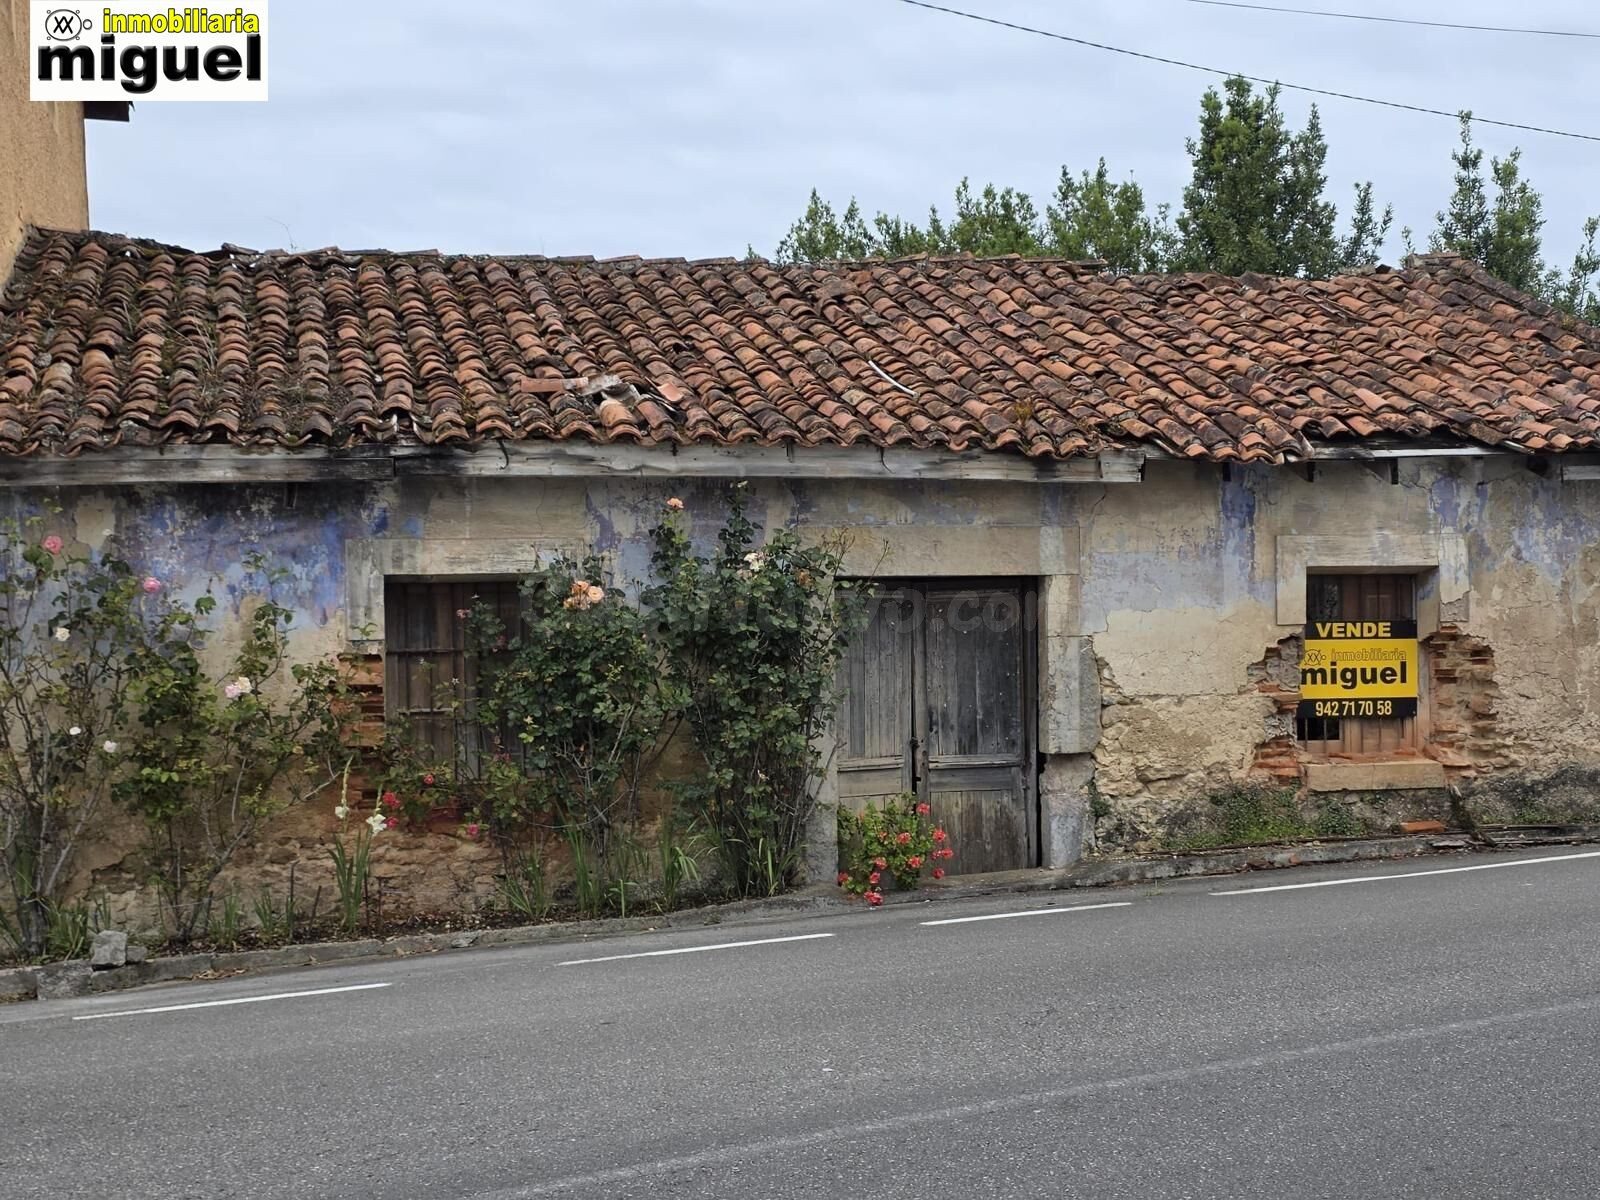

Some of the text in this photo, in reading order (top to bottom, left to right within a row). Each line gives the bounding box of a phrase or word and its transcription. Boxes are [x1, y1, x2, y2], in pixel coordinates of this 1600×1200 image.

[1316, 622, 1391, 638] VENDE
[1331, 648, 1406, 661] inmobiliaria
[1301, 661, 1407, 690] miguel
[1315, 700, 1392, 716] 942 71 70 58
